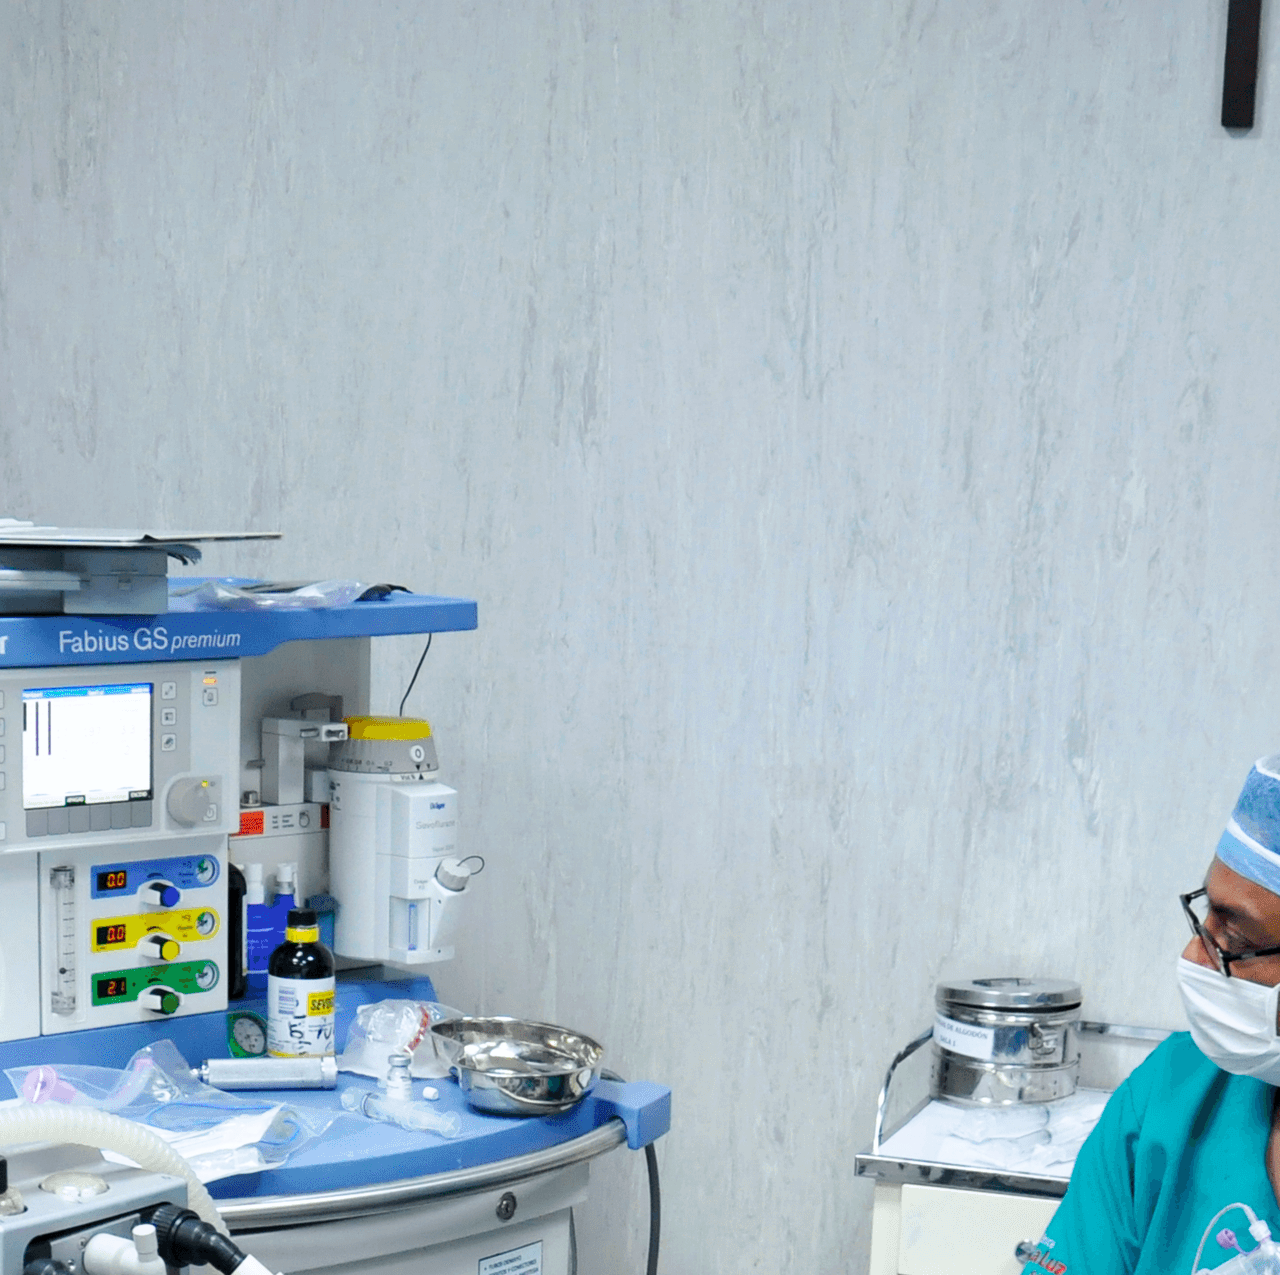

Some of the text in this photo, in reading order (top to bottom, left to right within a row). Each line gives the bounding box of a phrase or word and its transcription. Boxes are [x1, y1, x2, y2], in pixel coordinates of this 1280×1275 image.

[59, 627, 241, 654] Fabius GS premium
